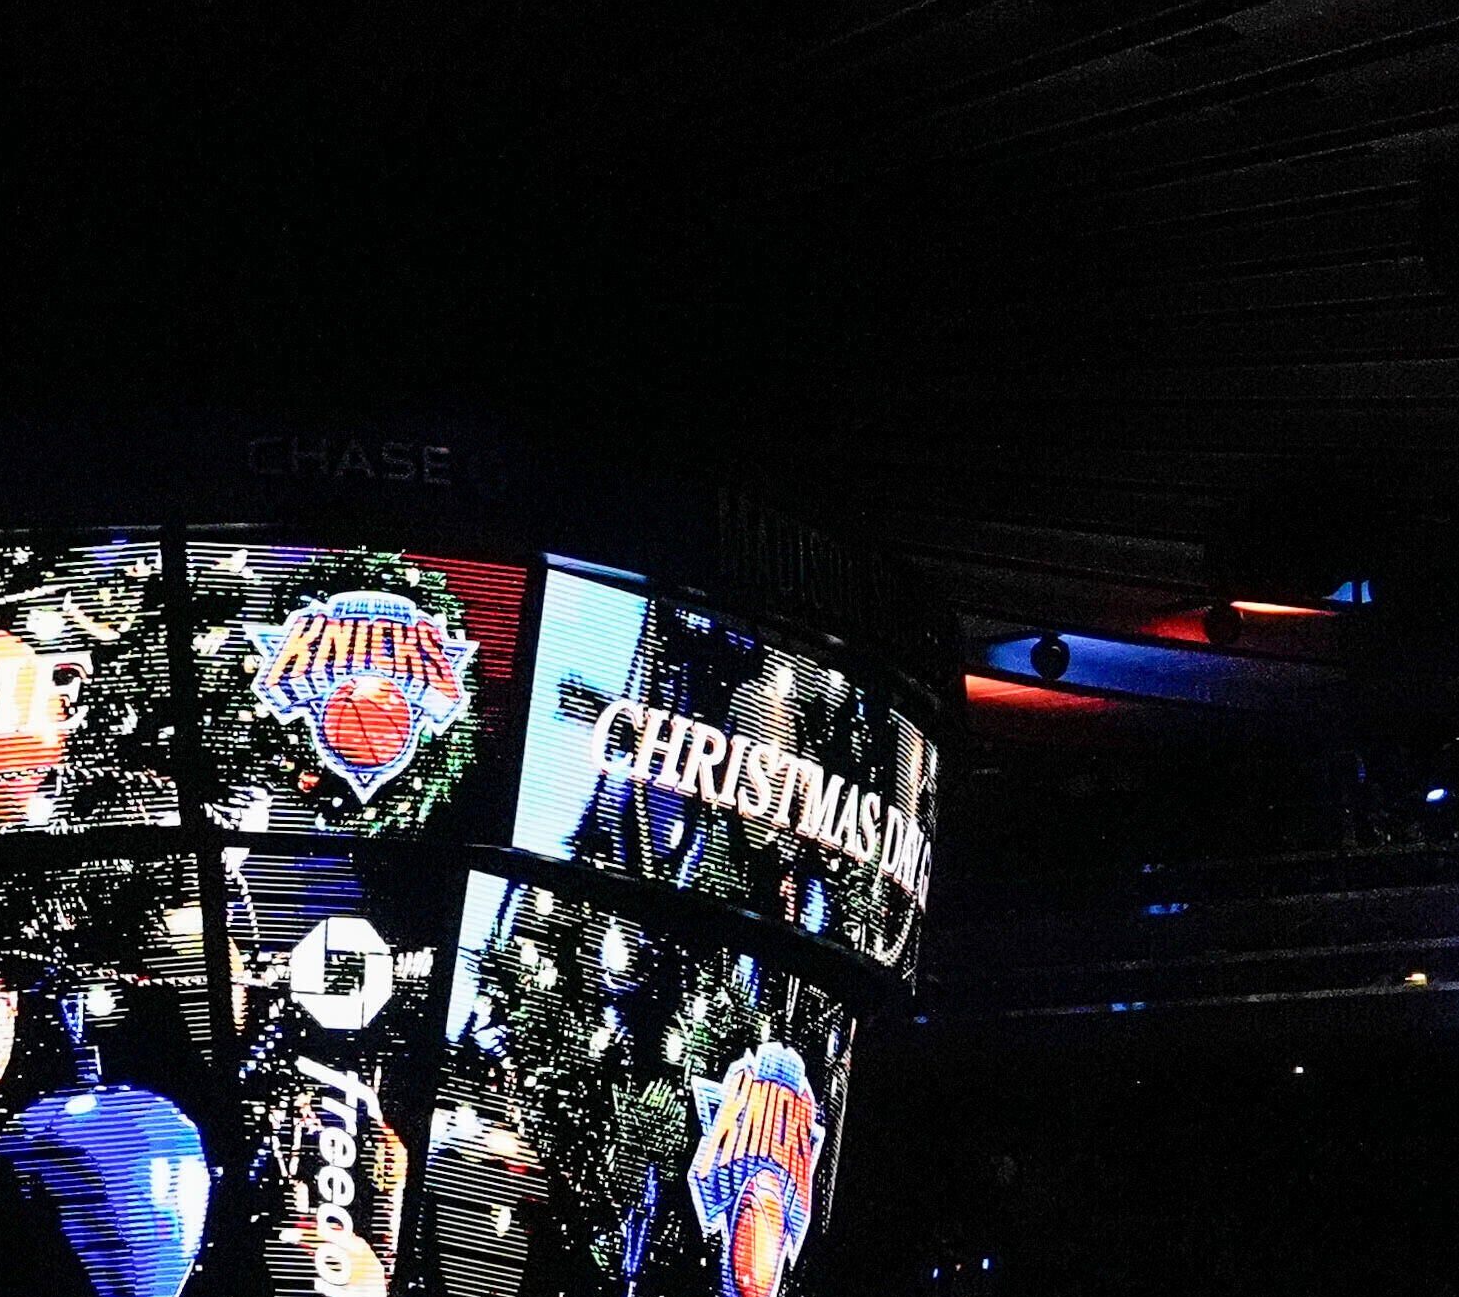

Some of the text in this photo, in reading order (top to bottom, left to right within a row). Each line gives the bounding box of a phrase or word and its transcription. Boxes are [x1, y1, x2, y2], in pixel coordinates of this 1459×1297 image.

[247, 436, 452, 487] CHASE
[265, 613, 461, 700] KNICKS
[590, 699, 881, 862] CHRISTMAS
